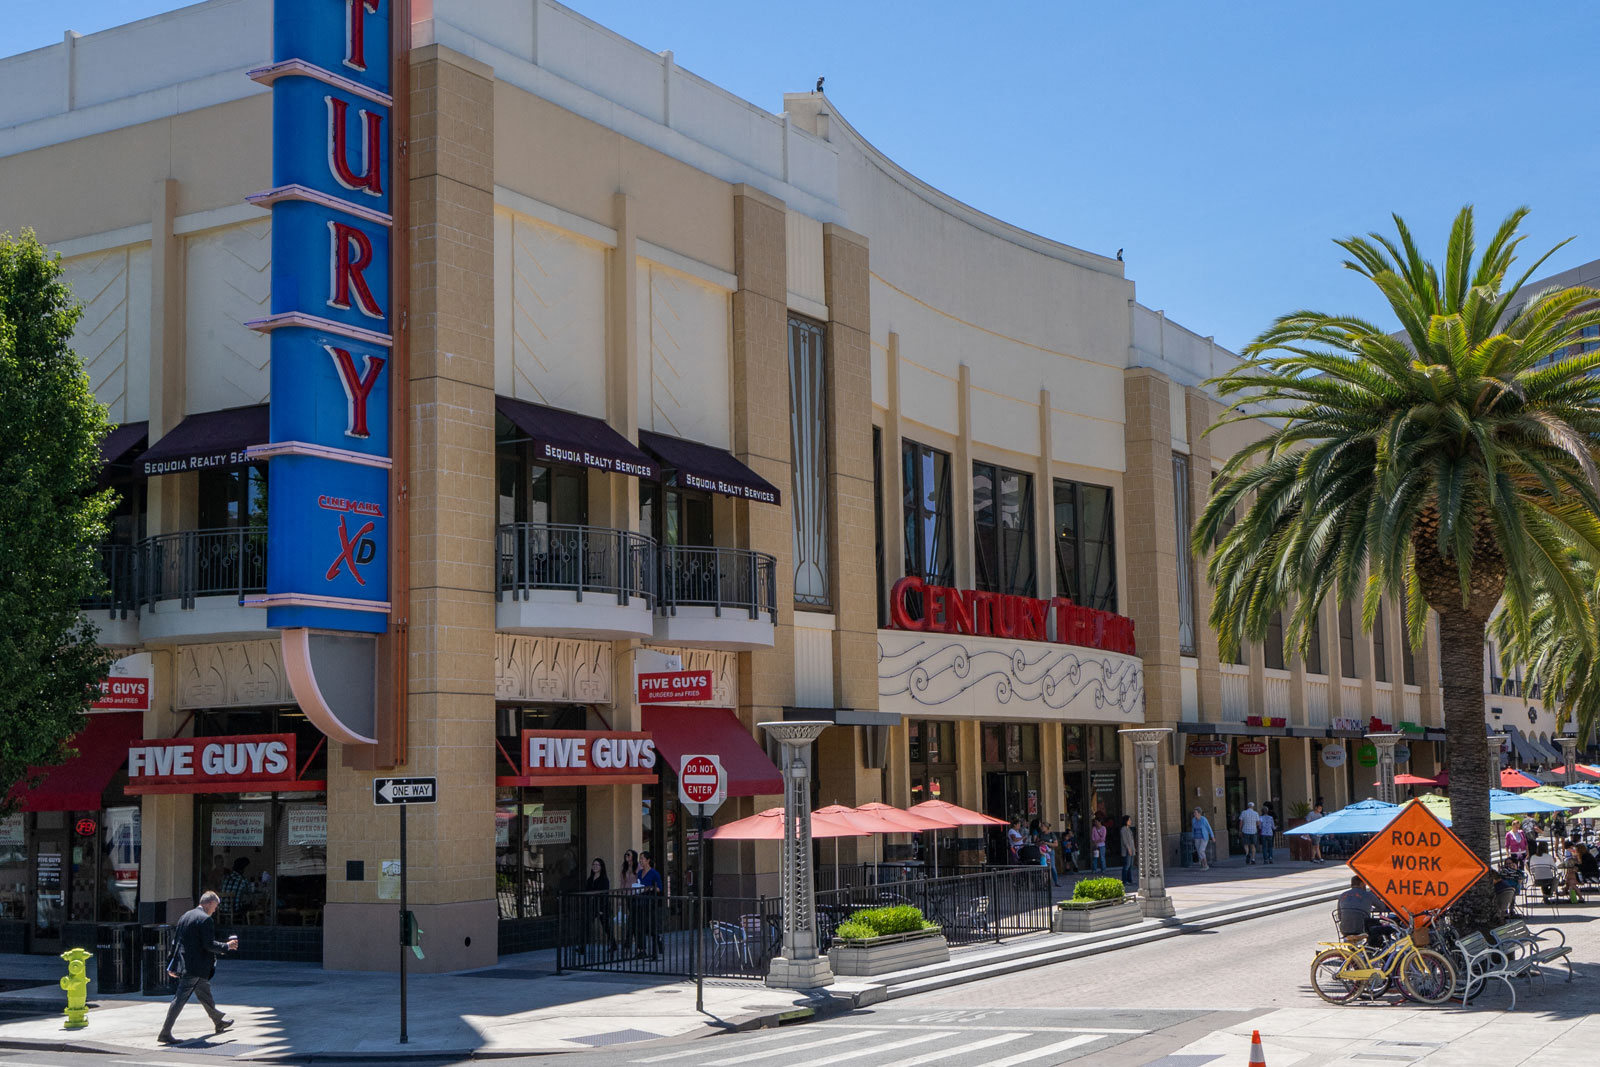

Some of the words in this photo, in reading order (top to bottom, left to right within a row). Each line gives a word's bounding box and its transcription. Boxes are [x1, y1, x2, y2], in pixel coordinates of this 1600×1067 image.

[144, 459, 187, 475] SEQUOIA
[190, 454, 227, 470] REALTY
[545, 444, 581, 462] SEQUOIA
[584, 452, 612, 469] REALTY
[615, 459, 651, 476] SERVICES
[686, 473, 716, 490] SEQUOIA
[718, 481, 742, 496] REALTY
[744, 486, 775, 503] SERVICES
[318, 494, 384, 517] CINEMARK
[890, 576, 1050, 641] CENTURY
[112, 682, 145, 695] GUYS
[641, 678, 669, 690] FIVE
[672, 675, 707, 689] GUYS
[128, 745, 194, 777] FIVE
[202, 741, 289, 775] GUYS
[529, 737, 586, 769] FIVE
[592, 737, 656, 769] GUYS
[687, 765, 697, 773] DO
[699, 765, 714, 773] NOT
[392, 786, 409, 796] ONE
[411, 785, 430, 796] WAY
[688, 786, 713, 794] ENTER
[532, 816, 548, 825] FIVE
[548, 815, 568, 824] GUYS
[1391, 830, 1441, 847] ROAD
[1391, 855, 1442, 871] WORK
[1385, 879, 1449, 896] AHEAD
